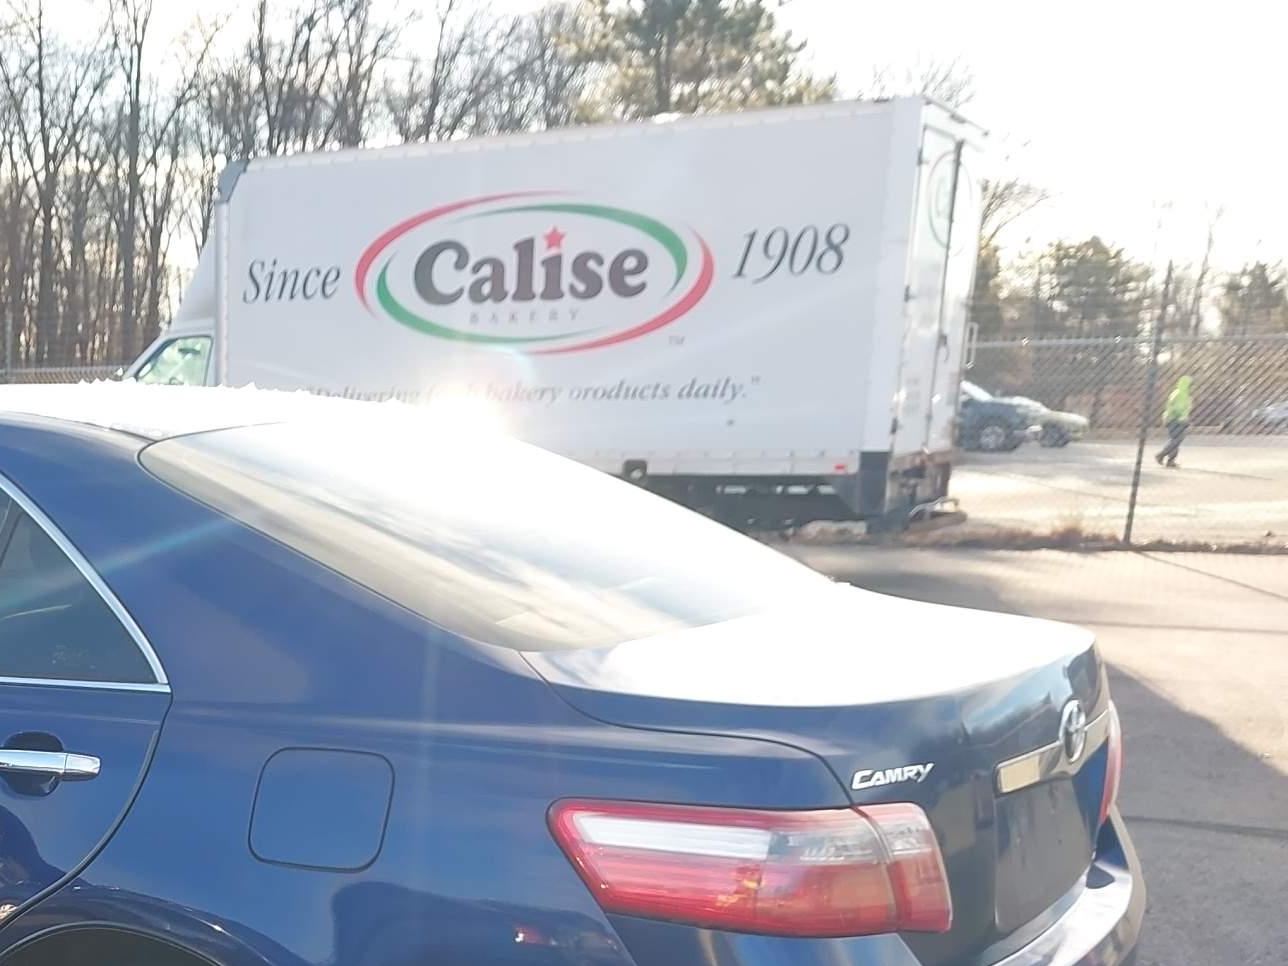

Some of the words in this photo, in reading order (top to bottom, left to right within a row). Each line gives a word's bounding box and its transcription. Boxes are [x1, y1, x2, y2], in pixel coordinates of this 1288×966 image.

[413, 226, 649, 306] Calise
[731, 222, 850, 285] 1908
[242, 257, 341, 304] Since
[469, 308, 580, 325] BAKERY
[850, 761, 936, 790] CAMRY
